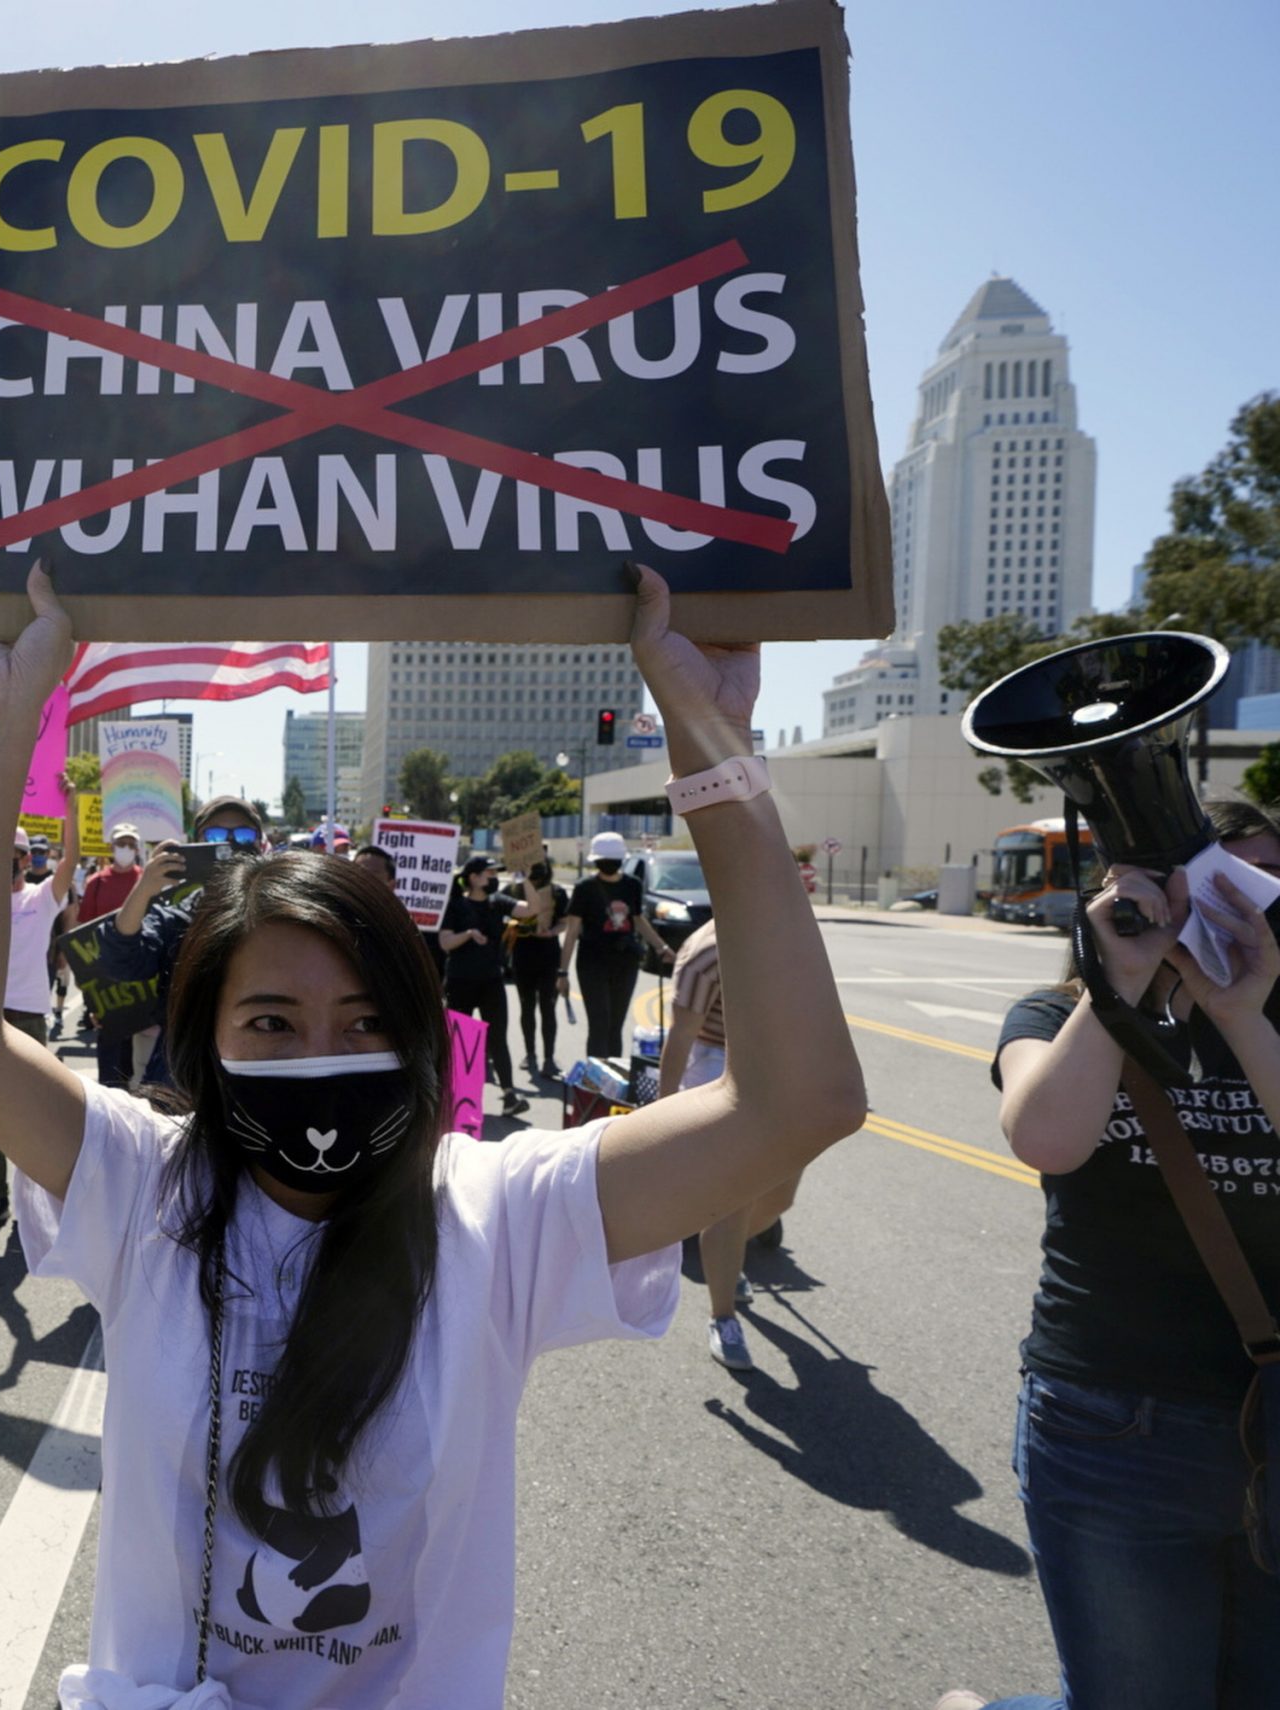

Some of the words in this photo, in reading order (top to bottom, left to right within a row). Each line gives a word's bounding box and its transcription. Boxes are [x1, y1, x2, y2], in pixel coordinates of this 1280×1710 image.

[377, 271, 797, 388] VIRUS
[422, 438, 817, 555] VIRUS
[377, 831, 415, 848] Fight
[395, 853, 418, 870] ian
[420, 853, 453, 874] Hate
[411, 878, 448, 896] Down
[273, 1635, 325, 1657] WHITE
